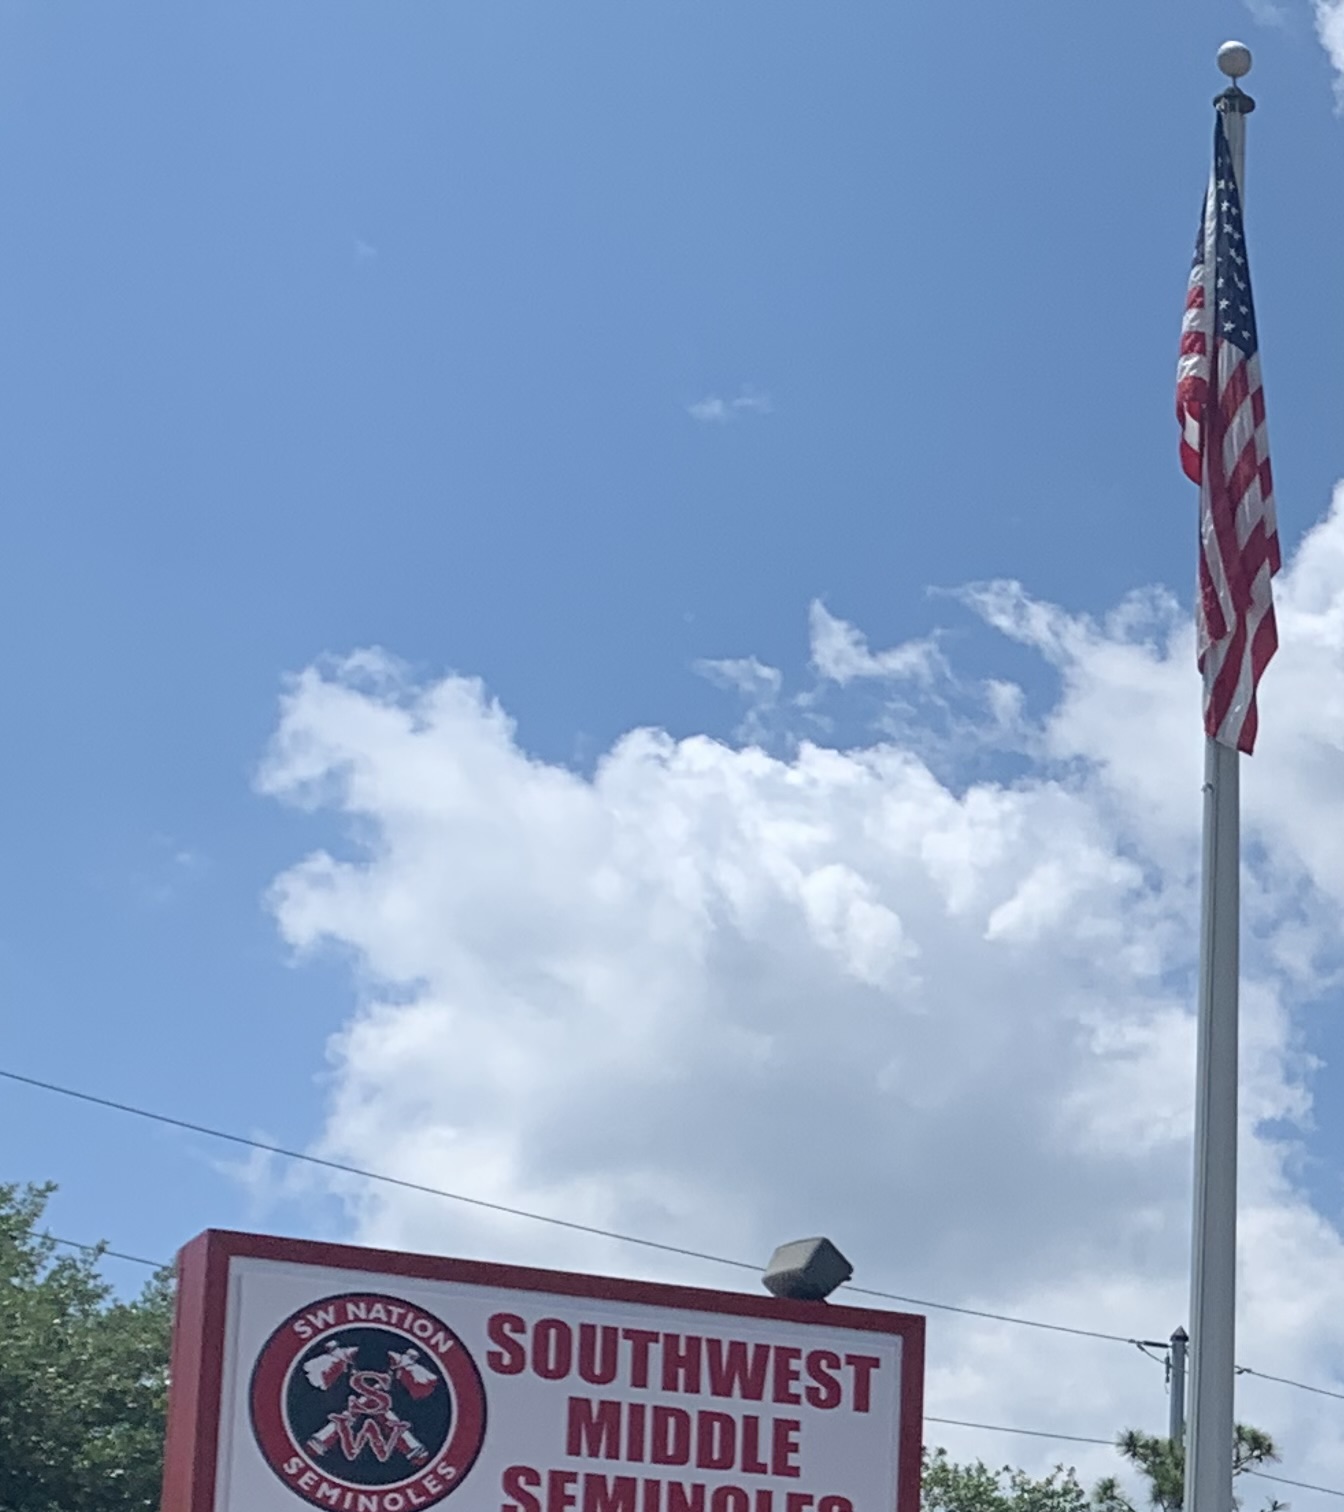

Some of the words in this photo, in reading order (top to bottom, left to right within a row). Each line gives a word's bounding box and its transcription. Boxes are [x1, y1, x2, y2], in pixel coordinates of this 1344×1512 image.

[293, 1305, 336, 1339] SW
[346, 1302, 455, 1354] NATION
[486, 1312, 881, 1413] SOUTHWEST
[566, 1396, 801, 1478] MIDDLE
